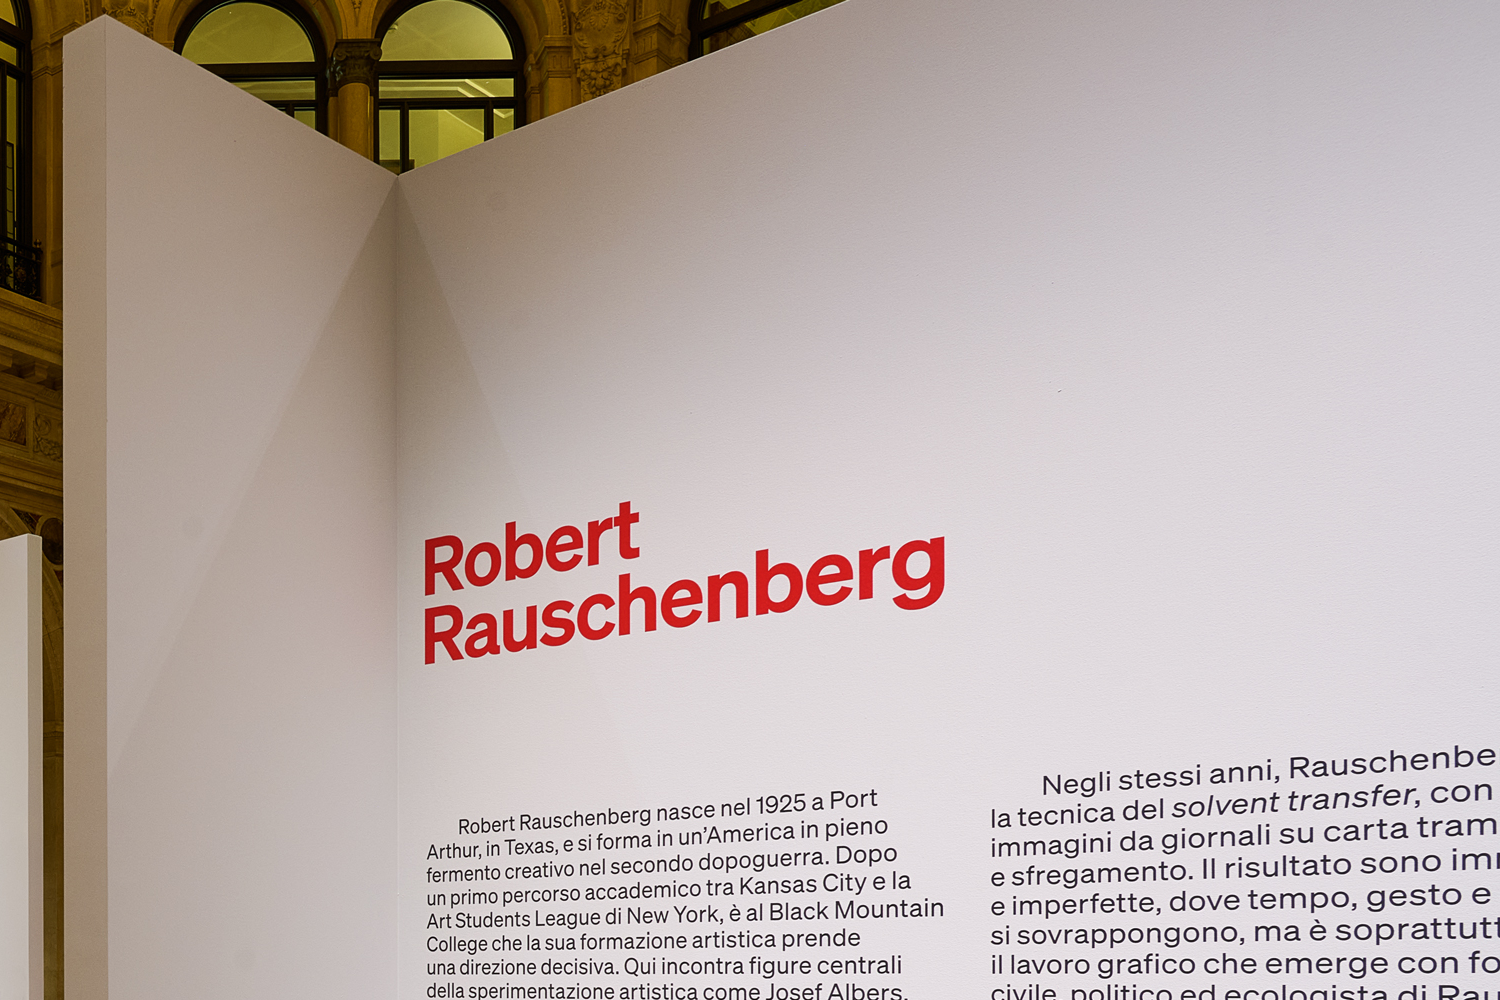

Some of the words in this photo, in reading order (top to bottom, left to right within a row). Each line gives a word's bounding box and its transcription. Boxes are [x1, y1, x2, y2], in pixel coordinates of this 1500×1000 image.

[424, 501, 640, 596] Robert
[424, 536, 945, 665] Rauschenberg
[1042, 770, 1111, 798] Negli
[1118, 763, 1201, 791] stessi
[1209, 758, 1280, 785] anni,
[458, 815, 516, 836] Robert
[519, 807, 651, 831] Rauschenberg
[656, 804, 716, 822] nasce
[720, 797, 751, 818] nel
[755, 792, 807, 815] 1925
[811, 796, 825, 811] a
[830, 788, 879, 810] Port
[426, 912, 453, 930] Art
[455, 911, 531, 929] Students
[535, 909, 601, 930] League
[605, 907, 622, 926] di
[627, 906, 670, 925] New
[673, 904, 724, 926] York,
[729, 903, 742, 922] è
[745, 902, 763, 922] al
[769, 900, 830, 921] Black
[835, 897, 944, 920] Mountain
[990, 900, 1006, 917] e
[1012, 892, 1162, 920] imperfette,
[1169, 890, 1241, 912] dove
[1247, 889, 1358, 914] tempo,
[1366, 883, 1463, 913] gesto
[1471, 886, 1492, 905] e
